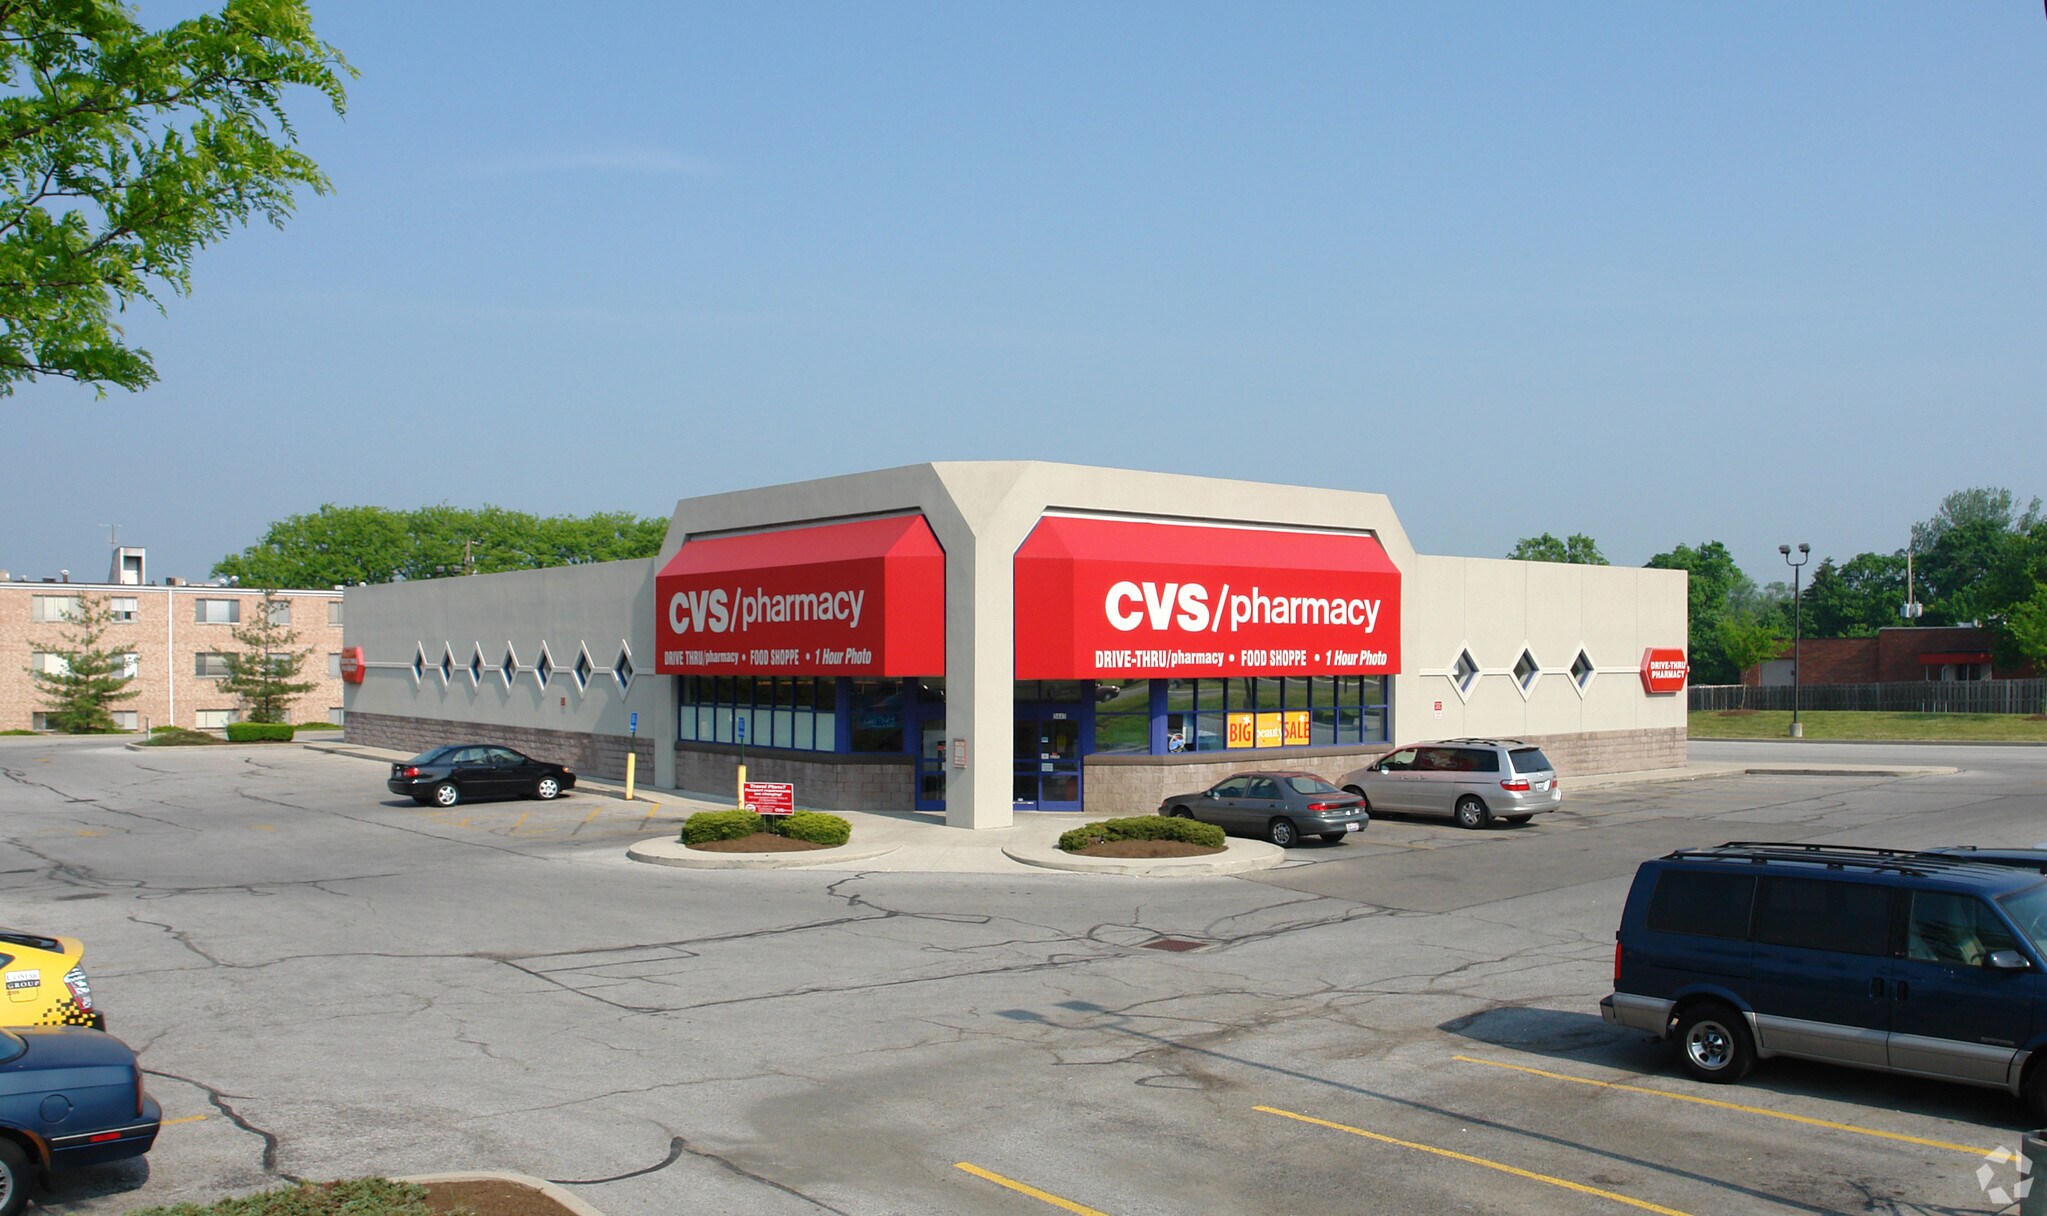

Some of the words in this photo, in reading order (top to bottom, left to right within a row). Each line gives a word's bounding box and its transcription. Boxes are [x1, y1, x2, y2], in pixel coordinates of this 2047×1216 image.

[669, 587, 865, 634] CVS/pharmacy
[1105, 580, 1381, 634] CVS/pharmacy
[664, 650, 684, 665] DRIVE
[750, 649, 769, 665] FOOD
[770, 648, 799, 665] SHOPPE
[815, 648, 821, 665] 1
[822, 648, 844, 664] Hour
[845, 647, 872, 664] Photo
[1095, 649, 1225, 668] DRIVE-THRU/pharmacy
[1241, 649, 1267, 666] FOOD
[1269, 649, 1307, 666] SHOPPE
[1325, 649, 1332, 665] 1
[1333, 649, 1359, 666] Hour
[1359, 649, 1388, 666] Photo
[1650, 661, 1686, 670] DRIVE-THRU
[1651, 670, 1685, 679] PHARMACY
[1229, 723, 1251, 742] BIG
[1284, 721, 1310, 739] SALE
[7, 980, 40, 989] GROUP
